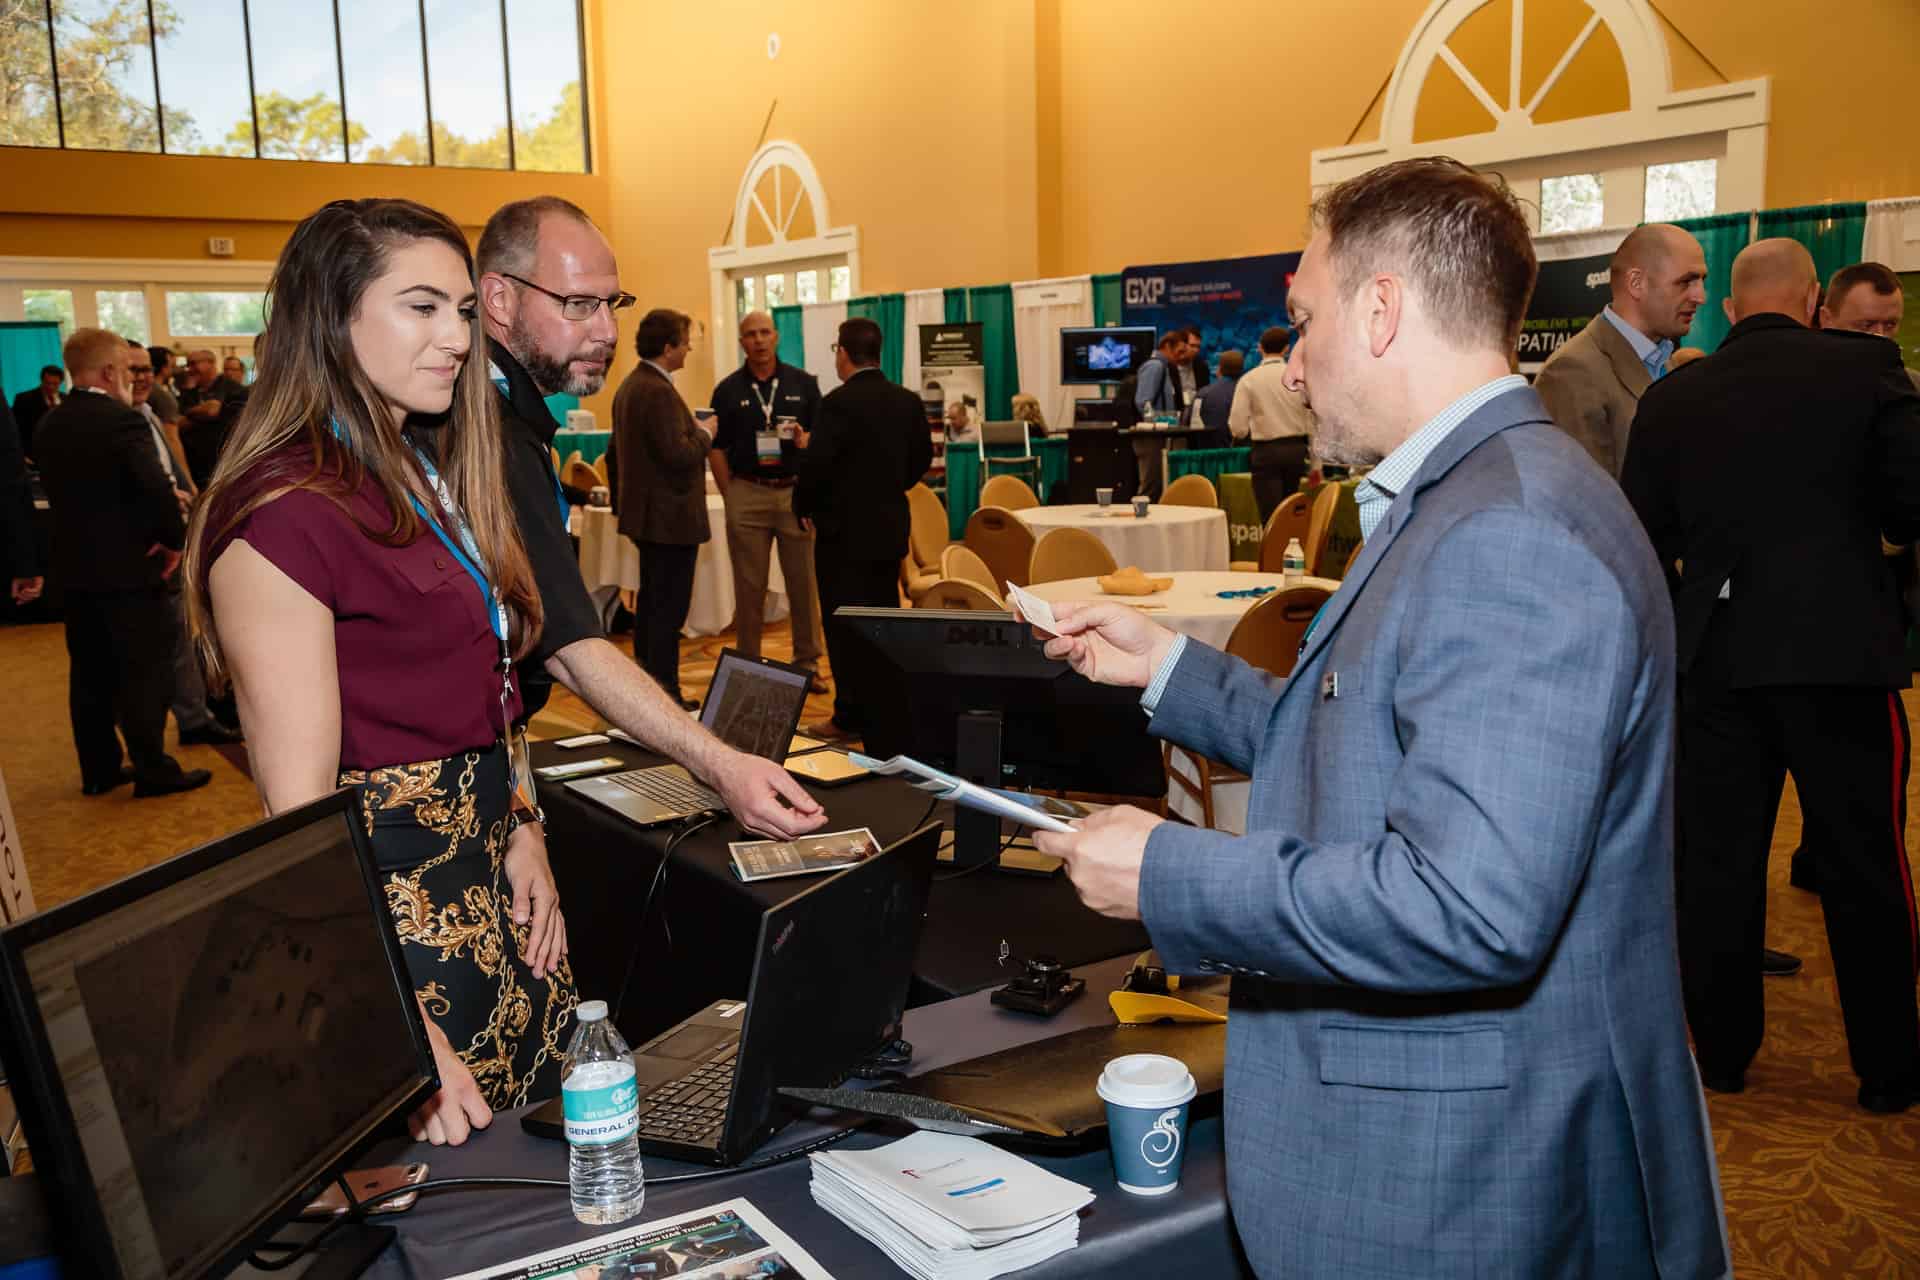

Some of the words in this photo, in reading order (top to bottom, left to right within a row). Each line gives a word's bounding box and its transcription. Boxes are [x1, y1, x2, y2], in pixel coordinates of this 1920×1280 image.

[1585, 268, 1611, 288] spat
[1125, 277, 1166, 304] GXP
[1514, 332, 1570, 352] PATIA
[568, 1122, 625, 1136] GENERAL
